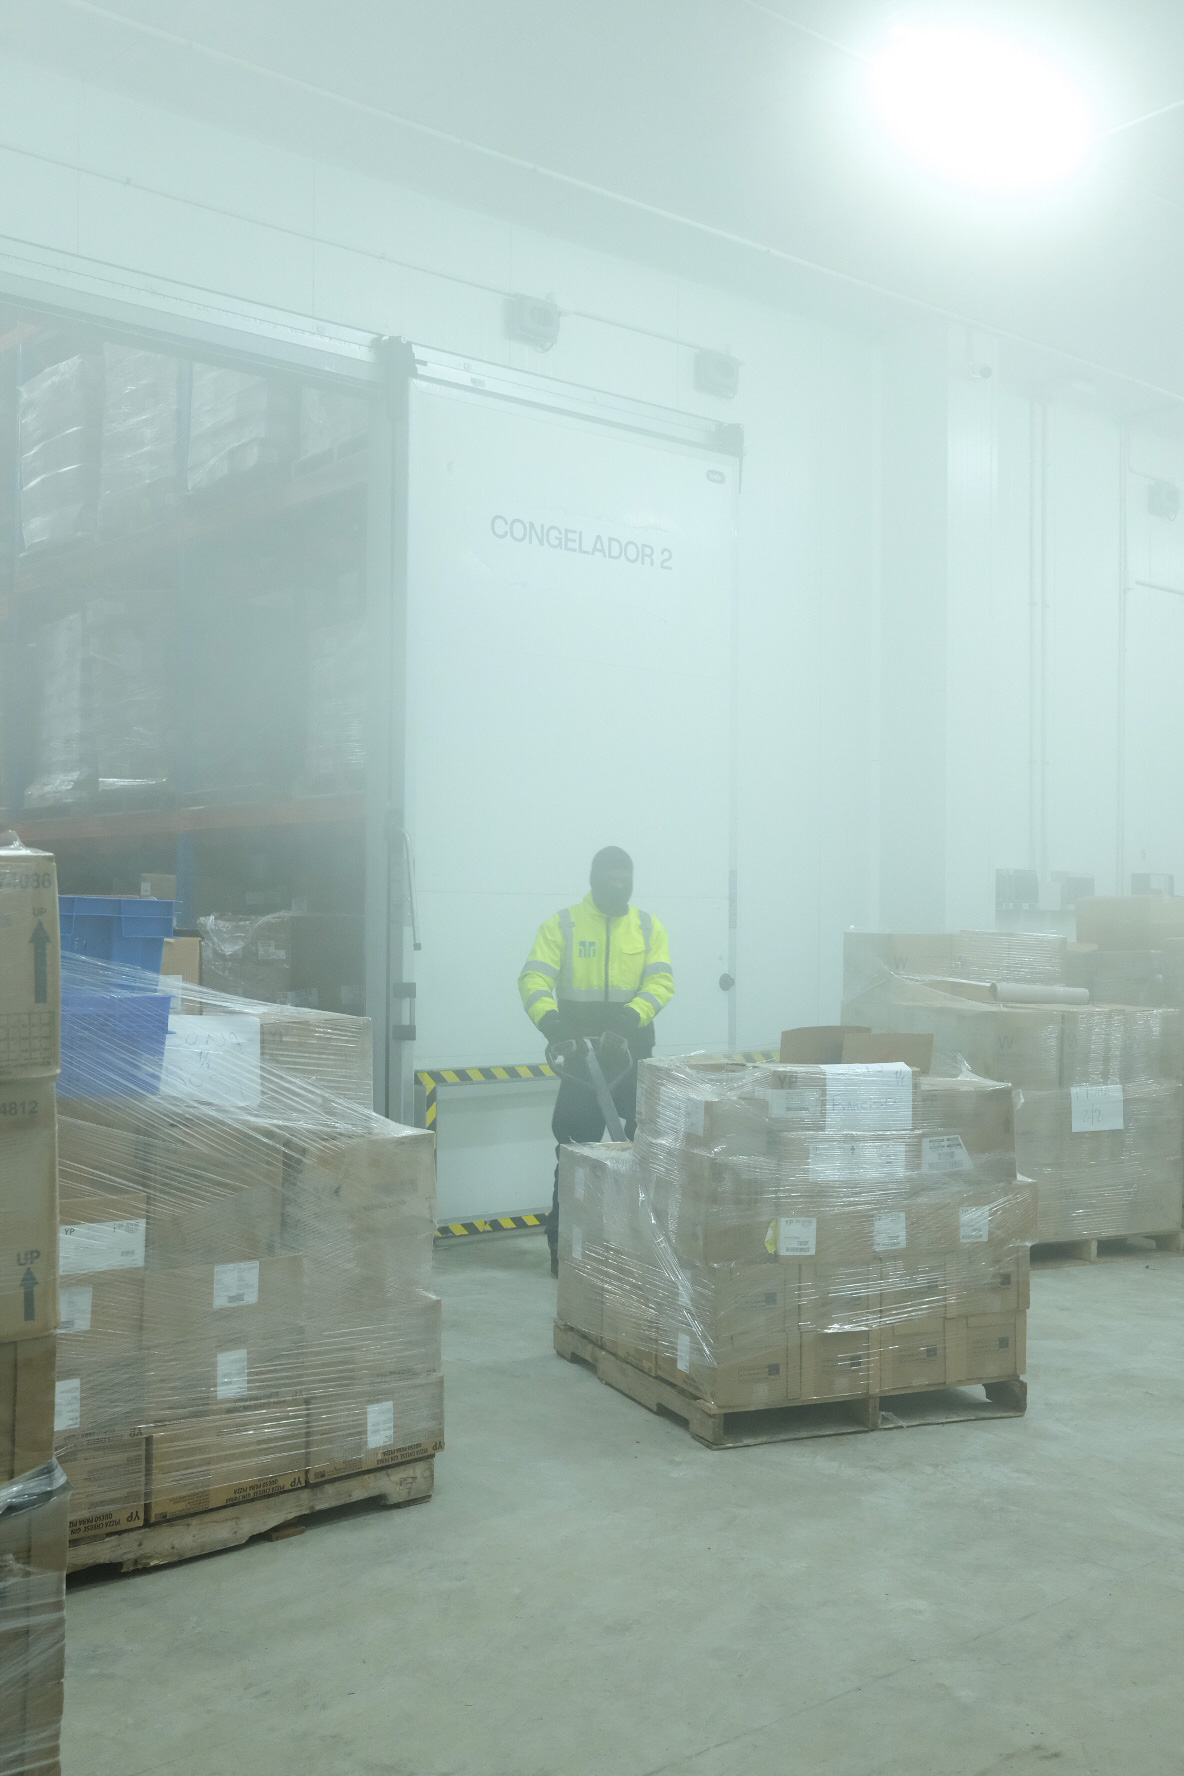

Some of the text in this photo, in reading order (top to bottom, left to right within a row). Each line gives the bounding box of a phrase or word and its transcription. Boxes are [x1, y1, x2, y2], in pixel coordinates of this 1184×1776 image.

[490, 514, 673, 571] CONGELADOR 2
[32, 906, 47, 917] UP
[998, 1034, 1014, 1050] W
[64, 1228, 75, 1236] YP
[16, 1249, 41, 1266] UP
[432, 1440, 443, 1451] YP
[290, 1476, 303, 1488] YP
[78, 1517, 94, 1526] PARA
[94, 1513, 113, 1523] QUESO
[126, 1510, 141, 1523] YP
[83, 1522, 104, 1533] CHEESE
[104, 1519, 121, 1528] PIZZA
